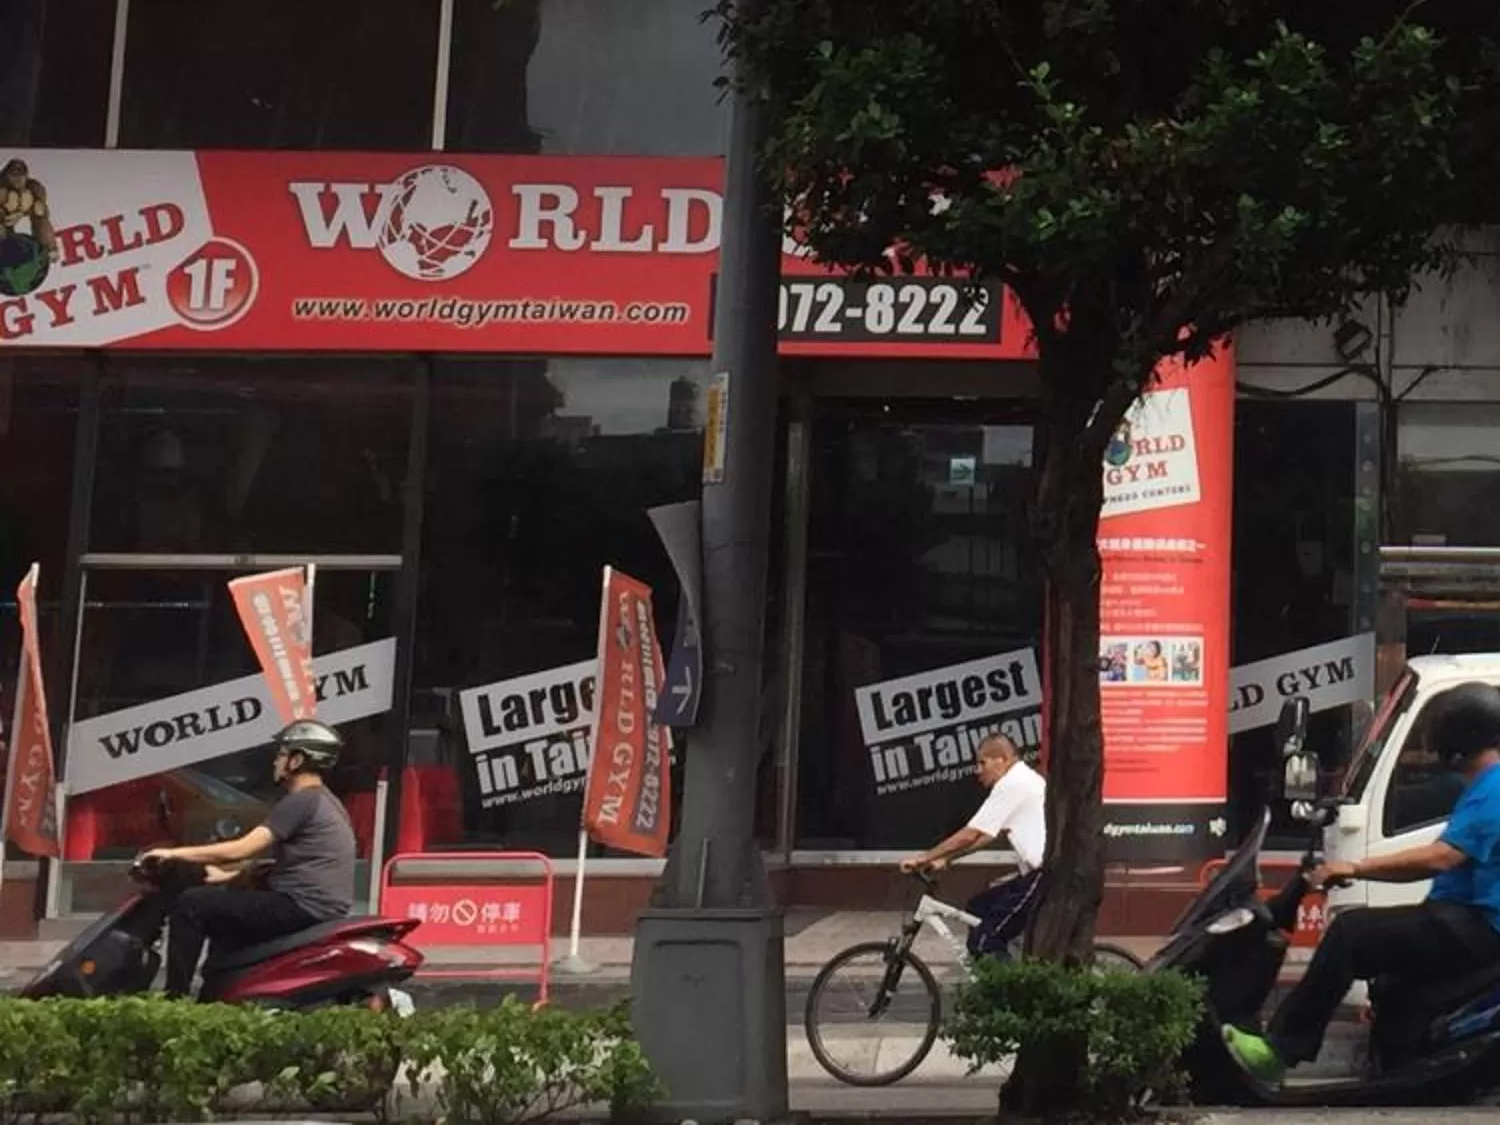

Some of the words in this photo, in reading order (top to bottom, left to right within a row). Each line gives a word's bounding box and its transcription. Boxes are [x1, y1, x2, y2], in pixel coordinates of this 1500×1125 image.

[0, 267, 146, 340] GYM
[183, 257, 237, 311] 1F
[293, 295, 690, 328] www.worldgymtaiwan.com
[1106, 460, 1168, 486] GYM
[477, 674, 599, 738] Large
[868, 660, 1029, 732] Largest
[1276, 656, 1356, 697] GYM
[98, 697, 263, 760] WORLD
[312, 664, 370, 703] YM
[475, 752, 520, 795] in
[524, 729, 592, 777] Tai
[870, 746, 910, 783] in
